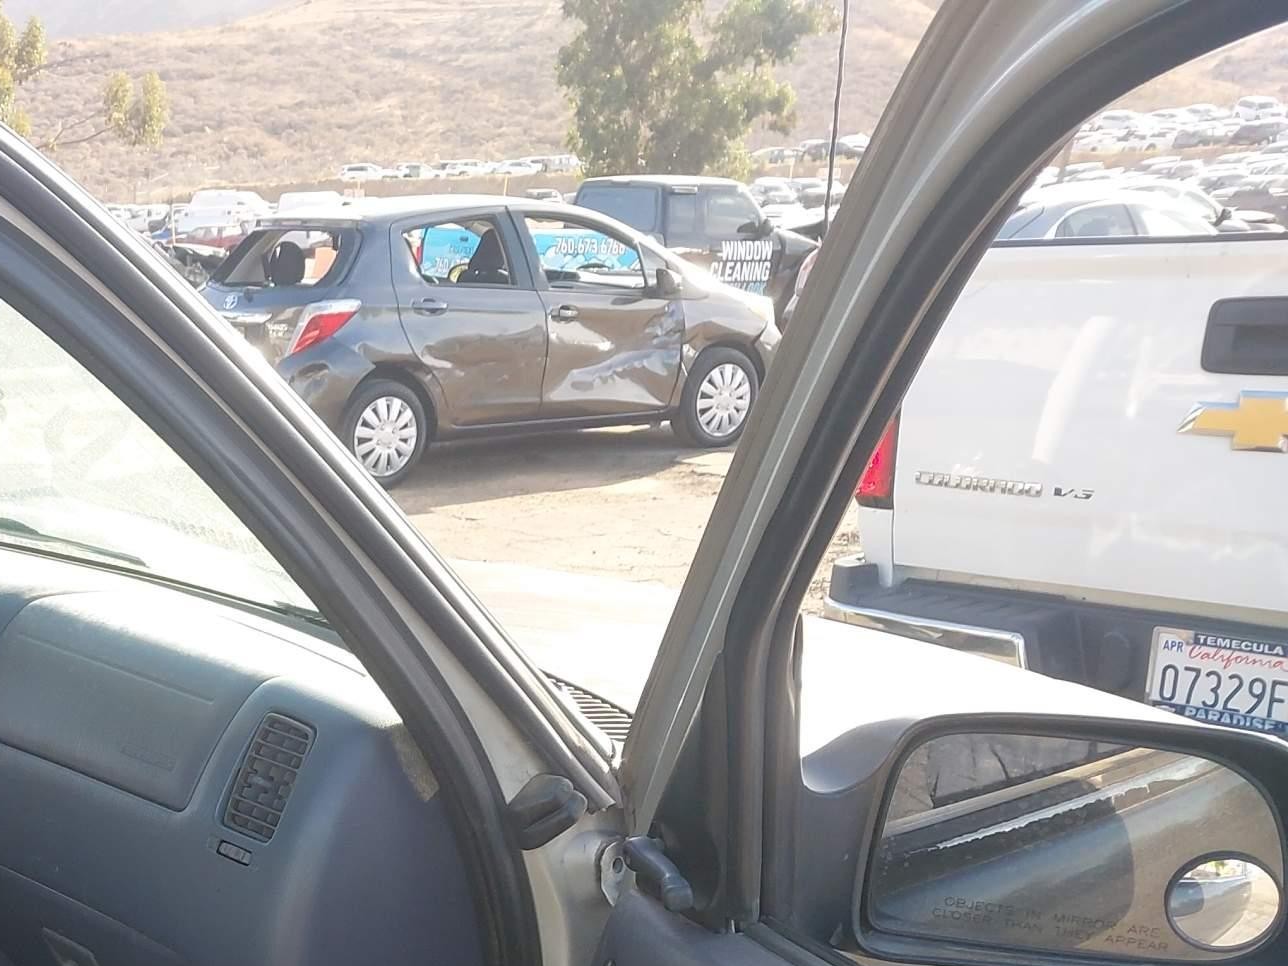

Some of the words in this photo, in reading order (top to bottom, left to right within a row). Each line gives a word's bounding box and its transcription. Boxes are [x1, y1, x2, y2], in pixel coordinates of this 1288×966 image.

[721, 240, 773, 261] WINDOW
[711, 261, 771, 282] CLEANING
[1162, 639, 1184, 653] APR
[1198, 637, 1285, 655] TEMECULA
[1187, 644, 1288, 672] California
[1184, 706, 1277, 730] PARADISE
[943, 895, 1016, 917] OBJECTS
[1024, 910, 1042, 921] IN
[1053, 913, 1119, 930] MIRROR
[1126, 924, 1161, 939] ARE
[931, 907, 993, 923] CLOSER
[1004, 917, 1043, 935] THAN
[1055, 926, 1095, 943] THEY
[1103, 935, 1170, 953] APPEAR
